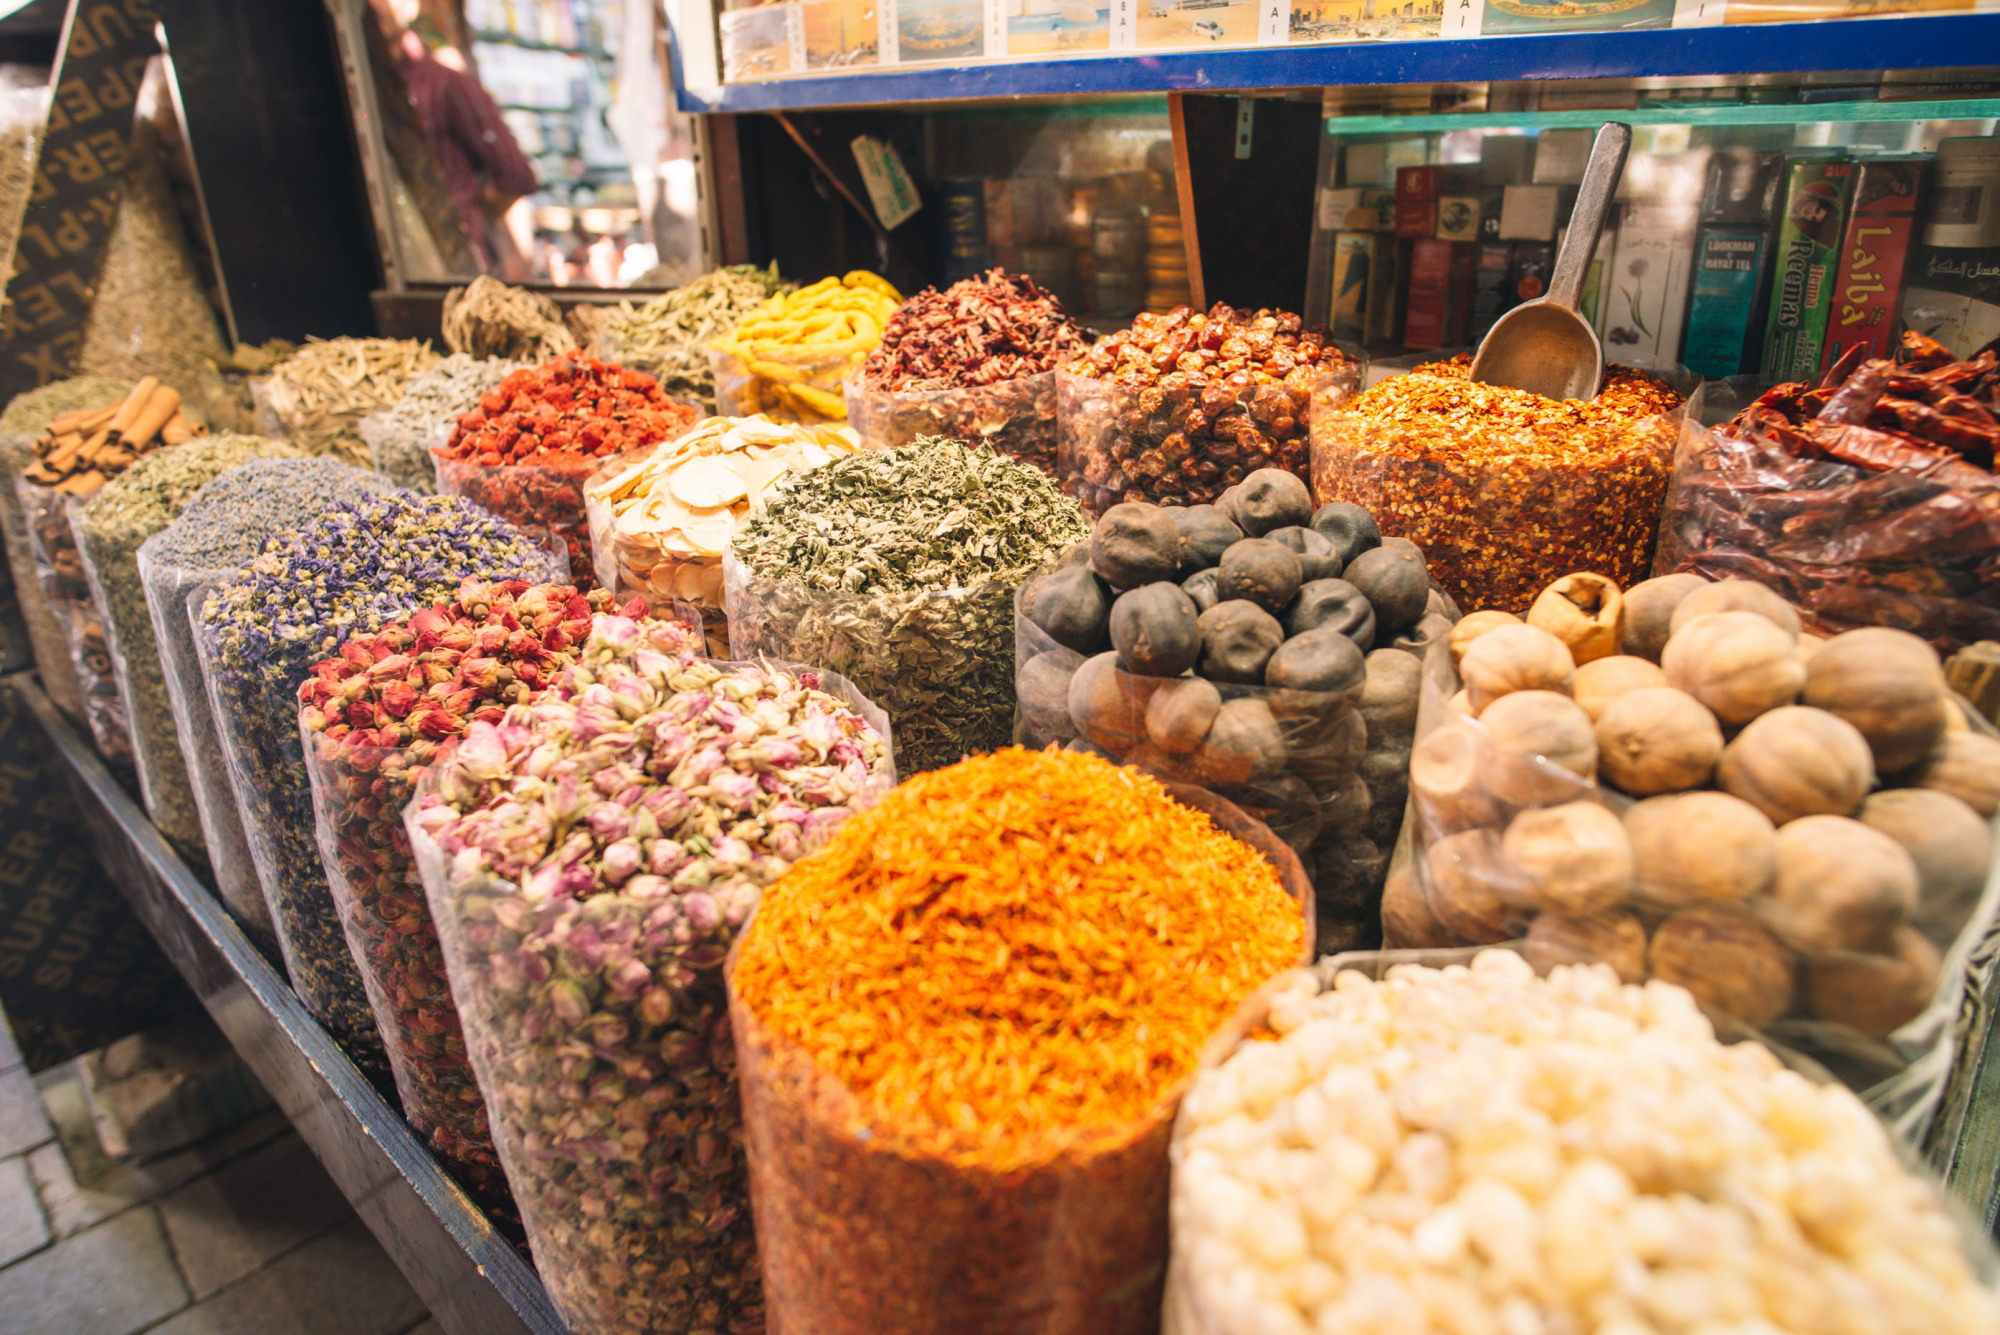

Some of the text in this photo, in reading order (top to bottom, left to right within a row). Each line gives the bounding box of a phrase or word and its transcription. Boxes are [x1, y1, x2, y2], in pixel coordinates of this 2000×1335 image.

[1705, 259, 1734, 269] HAYAT
[1708, 240, 1756, 251] LOOKMAN
[1778, 239, 1815, 327] Reemas
[1805, 264, 1827, 308] Henna
[1840, 225, 1892, 327] Laiba
